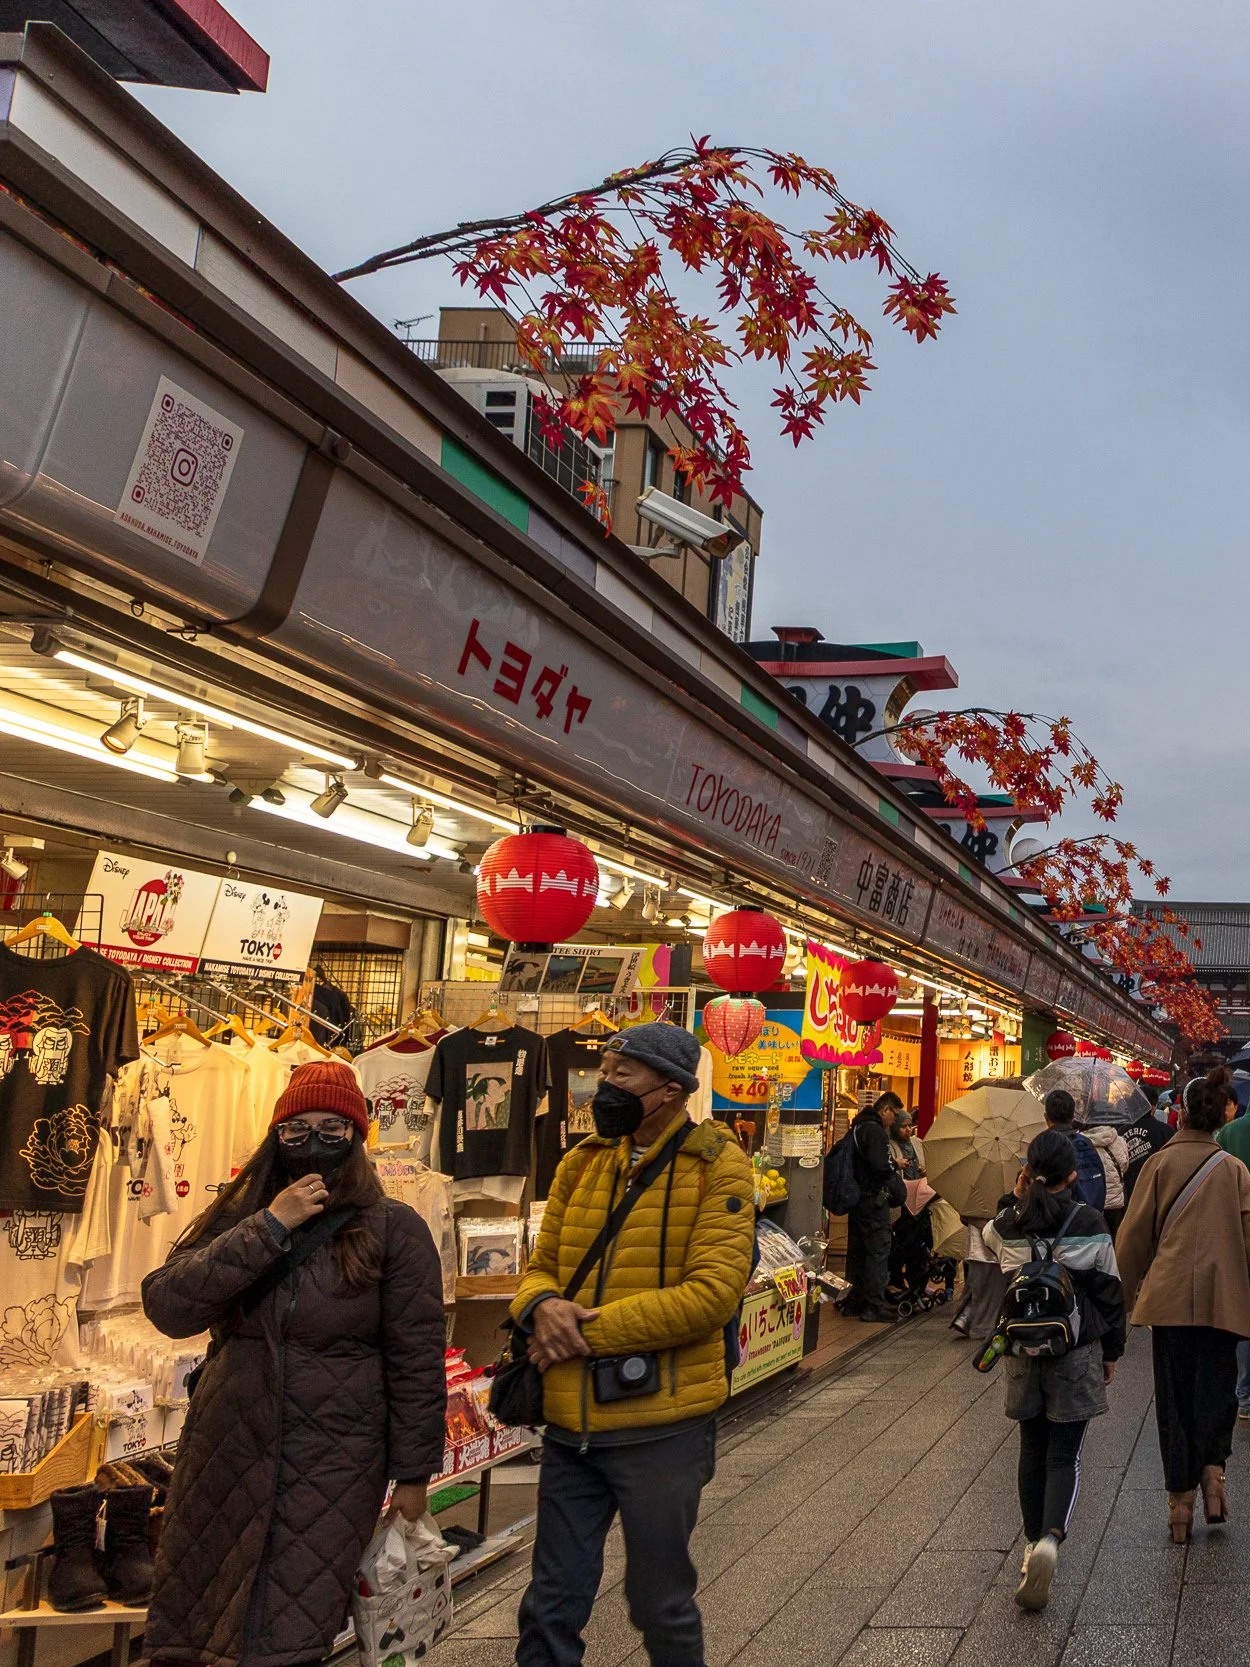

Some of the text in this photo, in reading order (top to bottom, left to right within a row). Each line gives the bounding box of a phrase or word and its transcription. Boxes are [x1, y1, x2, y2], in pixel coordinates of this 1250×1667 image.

[457, 618, 592, 735] トヨダヤ
[685, 764, 782, 852] TOYODAYA
[779, 845, 816, 872] since 1921
[856, 852, 915, 928] 中富商店
[108, 950, 138, 962] TOYODAYA
[143, 954, 161, 965] DISNEY
[162, 956, 194, 969] COLLECTION
[204, 962, 230, 974] NAKAMISE
[258, 969, 274, 979] DISNEY
[275, 971, 301, 982] COLLECTION
[724, 1052, 782, 1064] レモネード
[748, 1064, 779, 1072] squezed
[964, 1051, 974, 1083] 人形焼
